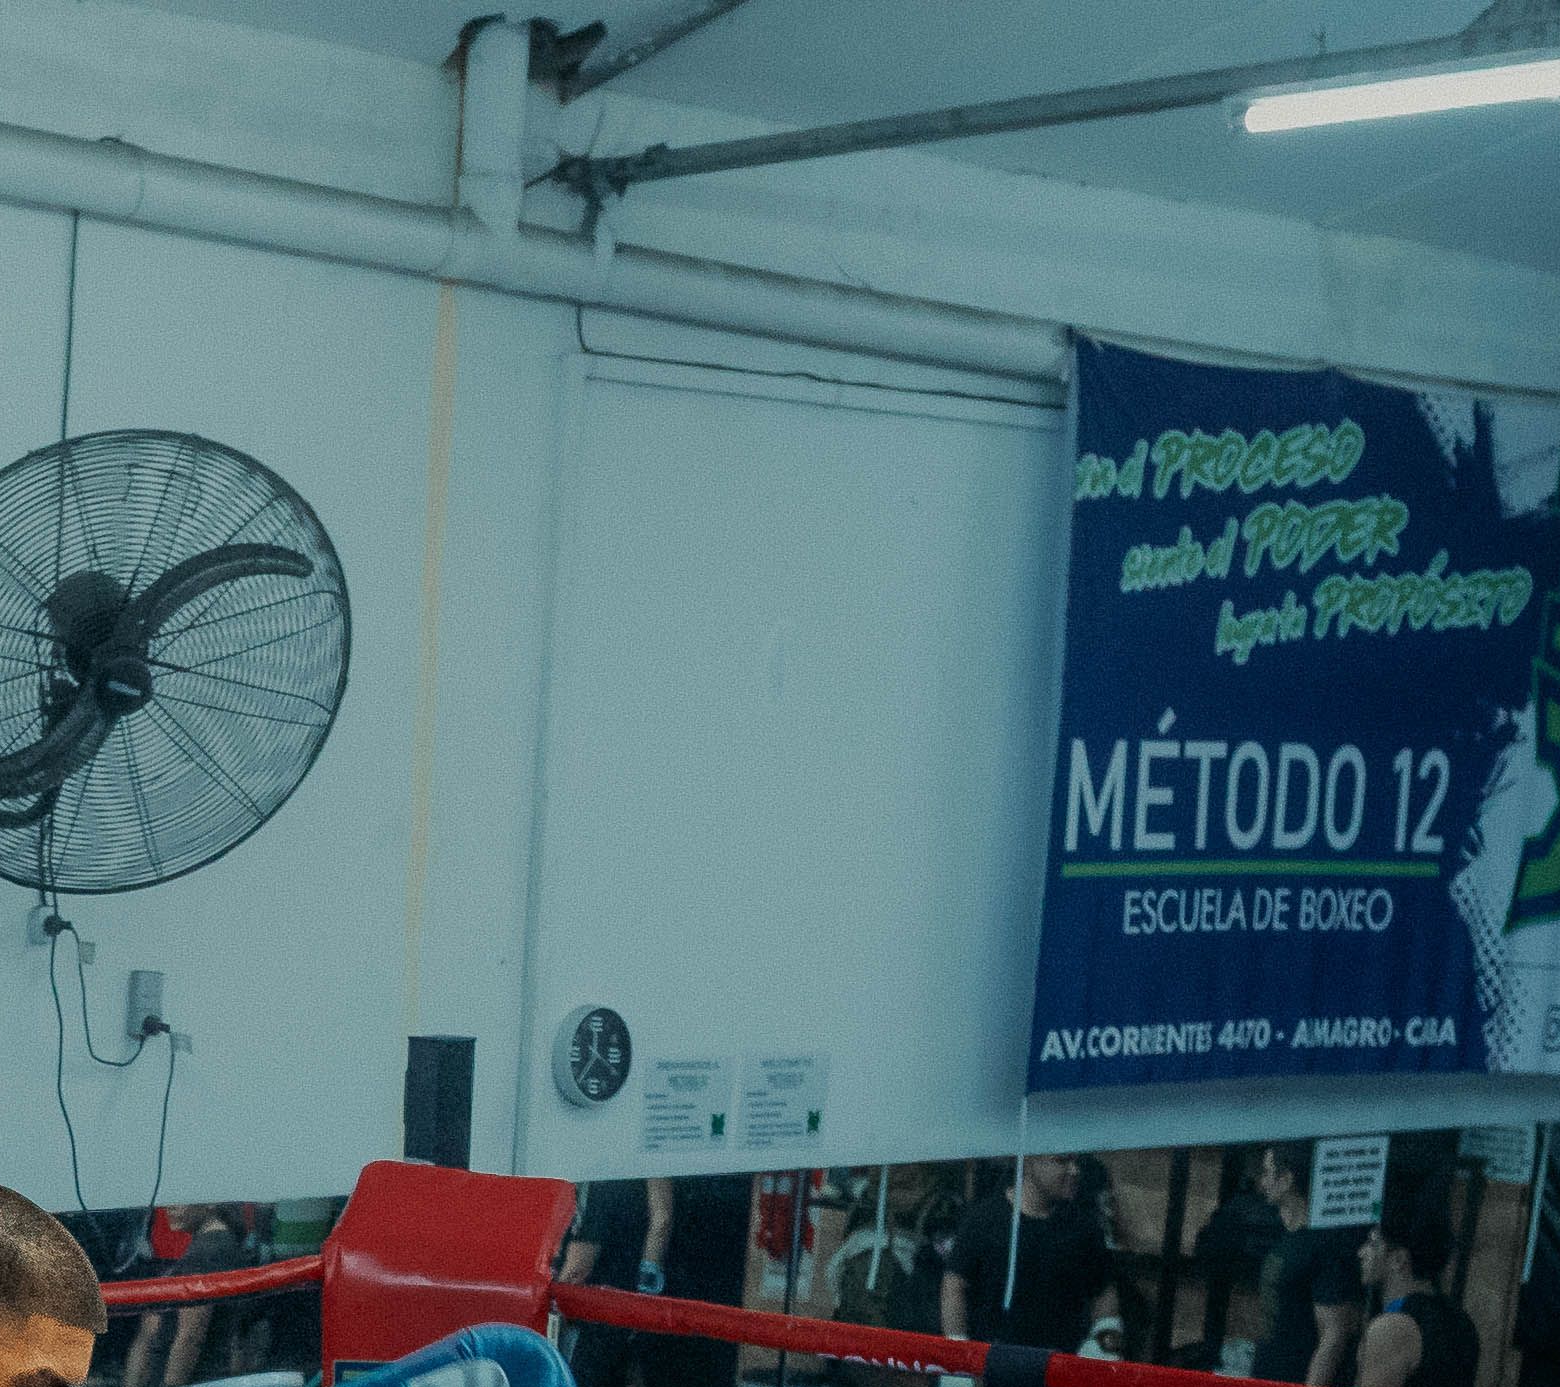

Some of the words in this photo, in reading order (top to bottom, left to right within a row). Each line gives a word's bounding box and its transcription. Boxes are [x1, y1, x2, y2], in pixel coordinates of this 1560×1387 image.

[1151, 416, 1367, 499] PROCESO
[1242, 493, 1410, 577] PODER
[1313, 548, 1534, 642] PROPÓSITO
[1064, 706, 1367, 852] MÉTODO
[1393, 747, 1451, 853] 12
[1123, 887, 1247, 936] ESCUELA
[1252, 887, 1292, 932] DE
[1299, 888, 1394, 933] BOXEO
